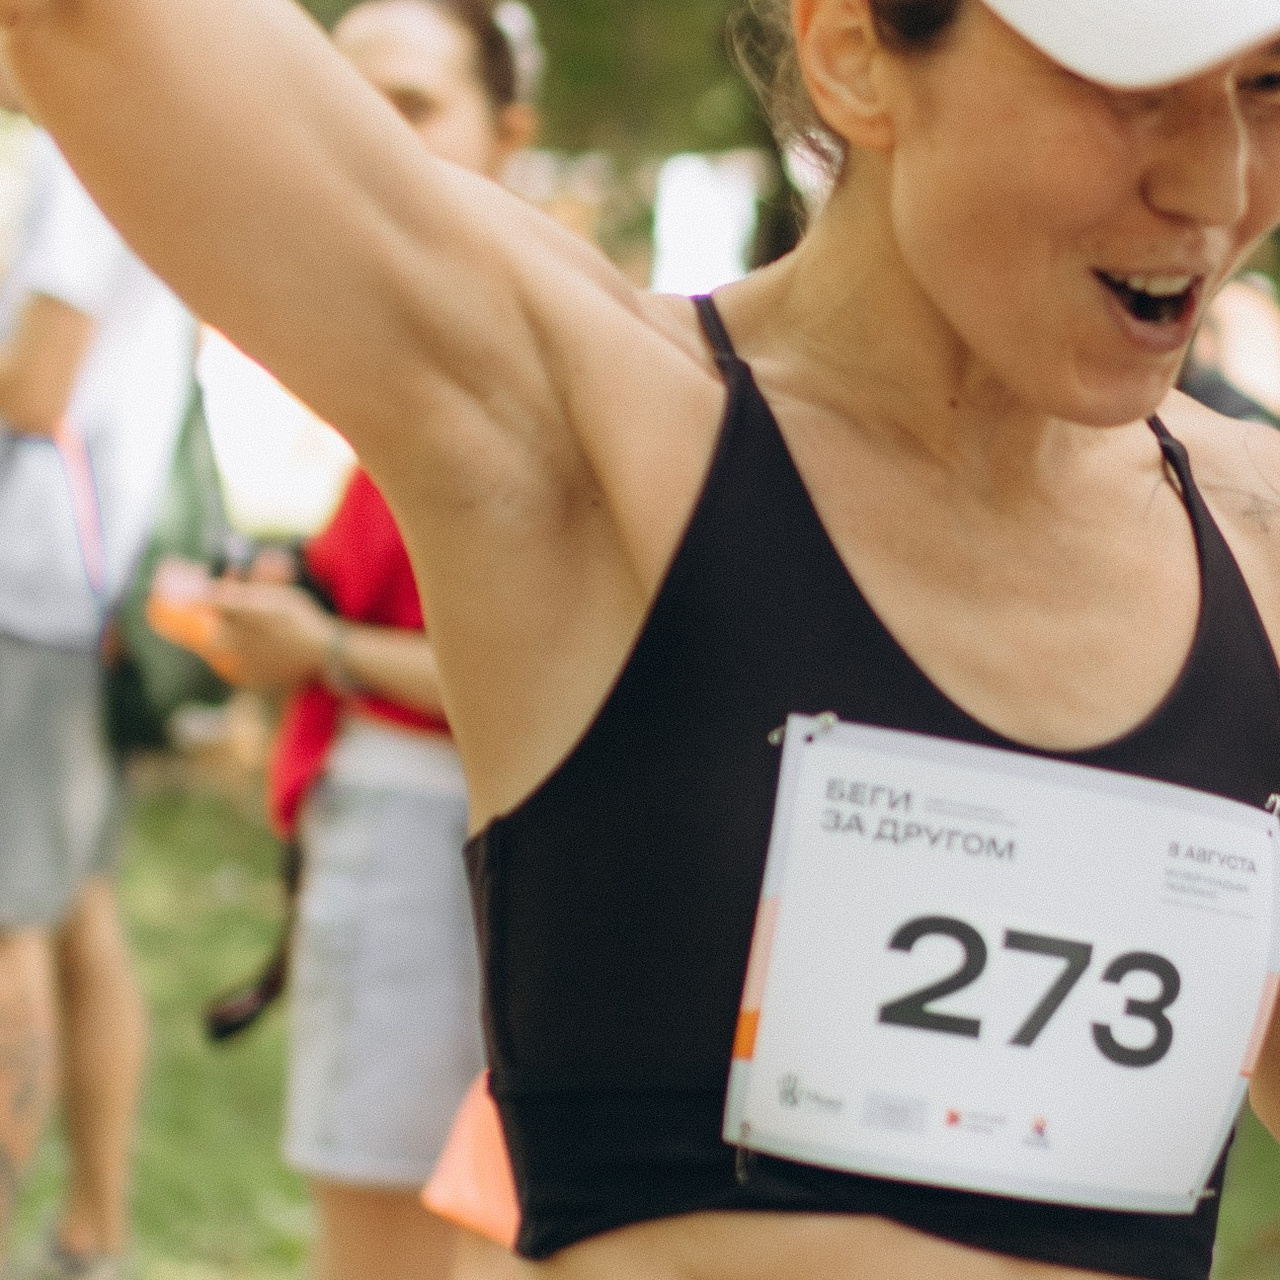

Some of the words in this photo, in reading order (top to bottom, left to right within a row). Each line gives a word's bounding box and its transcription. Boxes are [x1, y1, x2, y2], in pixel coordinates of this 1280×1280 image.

[826, 777, 912, 811] БЕГИ
[822, 808, 864, 835] ЗА
[874, 818, 1015, 860] ДРУГОМ
[1184, 843, 1257, 874] АВГУСТА
[876, 914, 1182, 1068] 273
